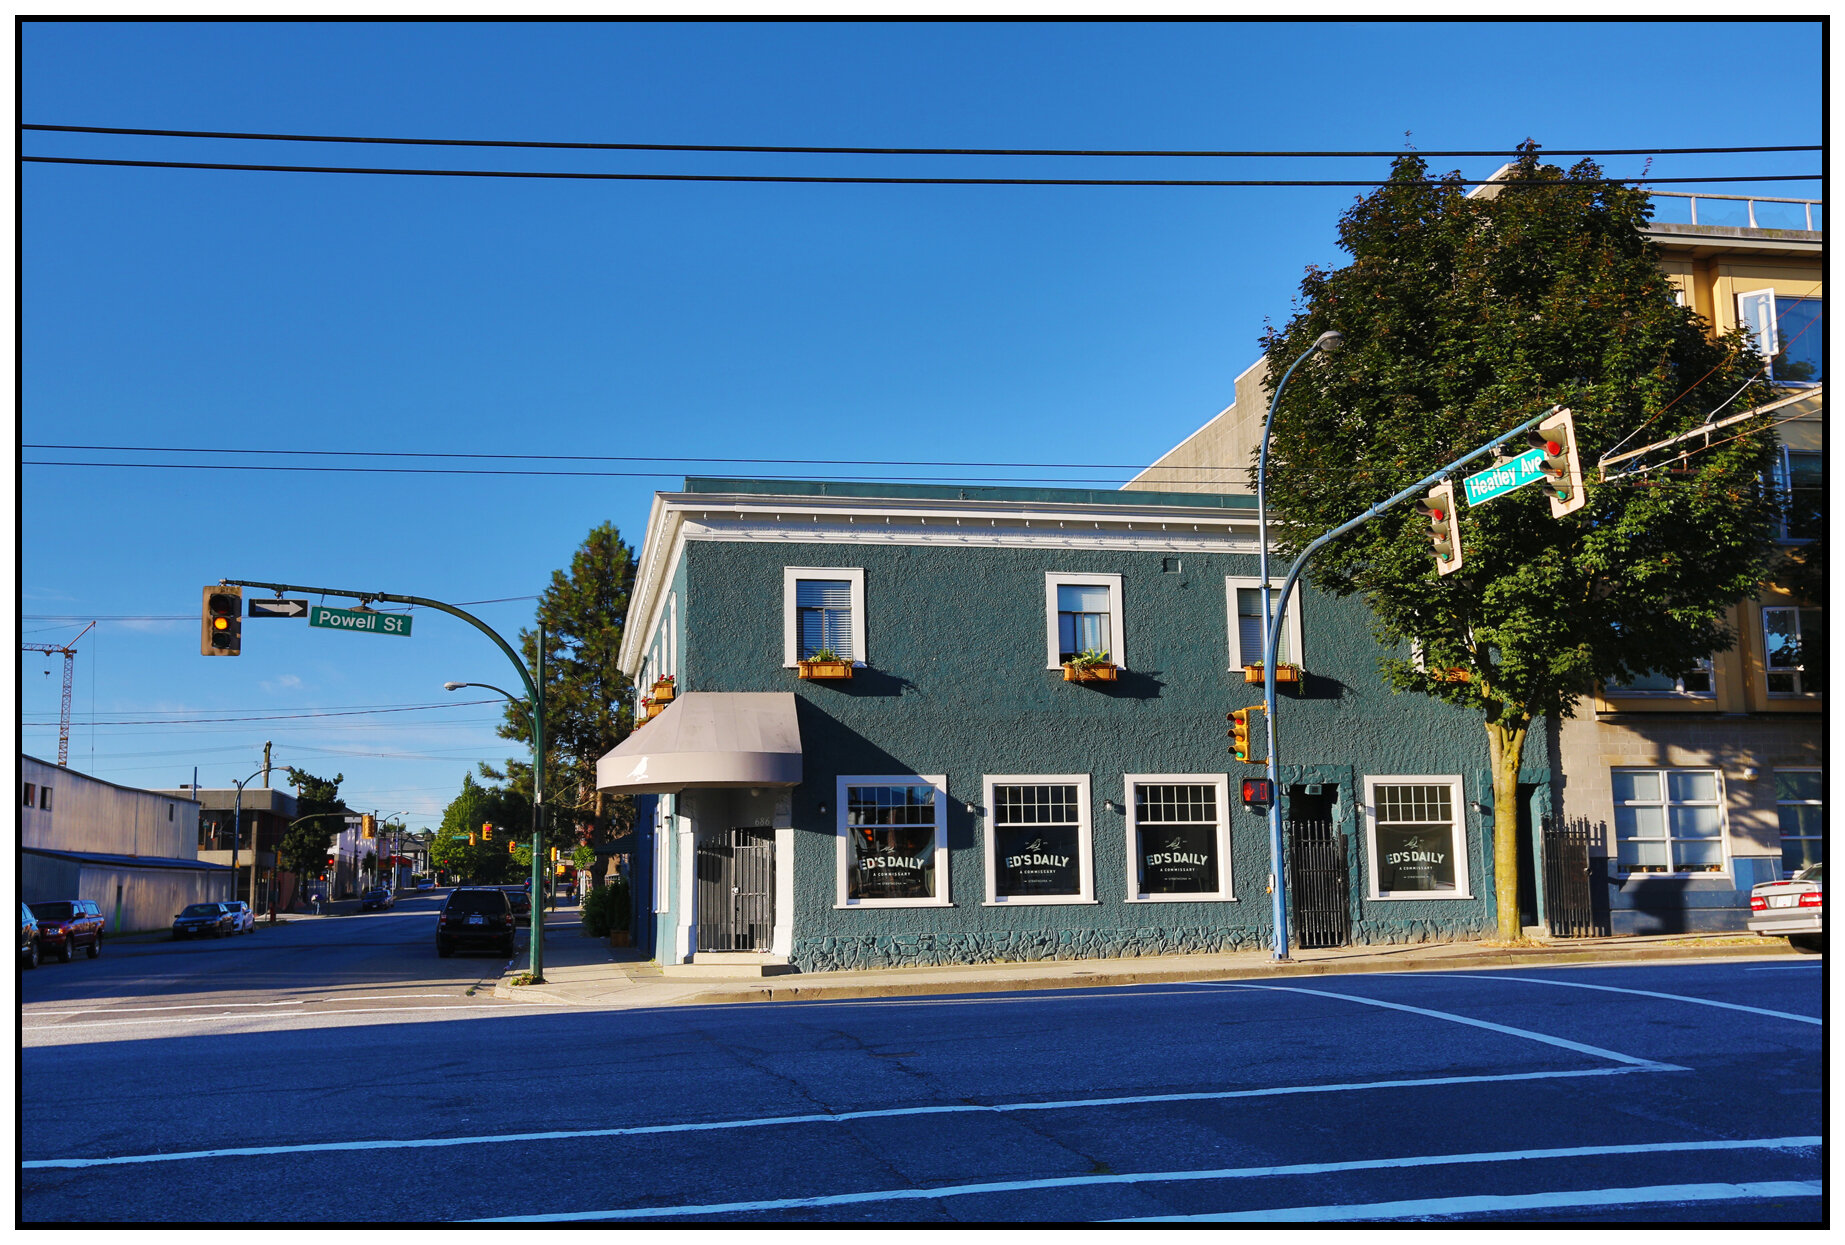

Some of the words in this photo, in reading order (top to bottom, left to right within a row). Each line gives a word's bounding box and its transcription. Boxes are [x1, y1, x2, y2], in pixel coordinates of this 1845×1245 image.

[1469, 467, 1516, 498] Heatley
[1520, 456, 1543, 478] Ave
[319, 610, 376, 630] Powell
[383, 617, 404, 633] St
[754, 816, 770, 826] 686
[859, 856, 887, 871] ED'S
[887, 856, 925, 870] DAILY
[1005, 854, 1032, 869] ED'S
[1033, 854, 1070, 868] DAILY
[1146, 852, 1172, 866] ED'S
[1173, 852, 1208, 866] DAILY
[1386, 851, 1411, 865] ED'S
[1411, 851, 1445, 864] DAILY
